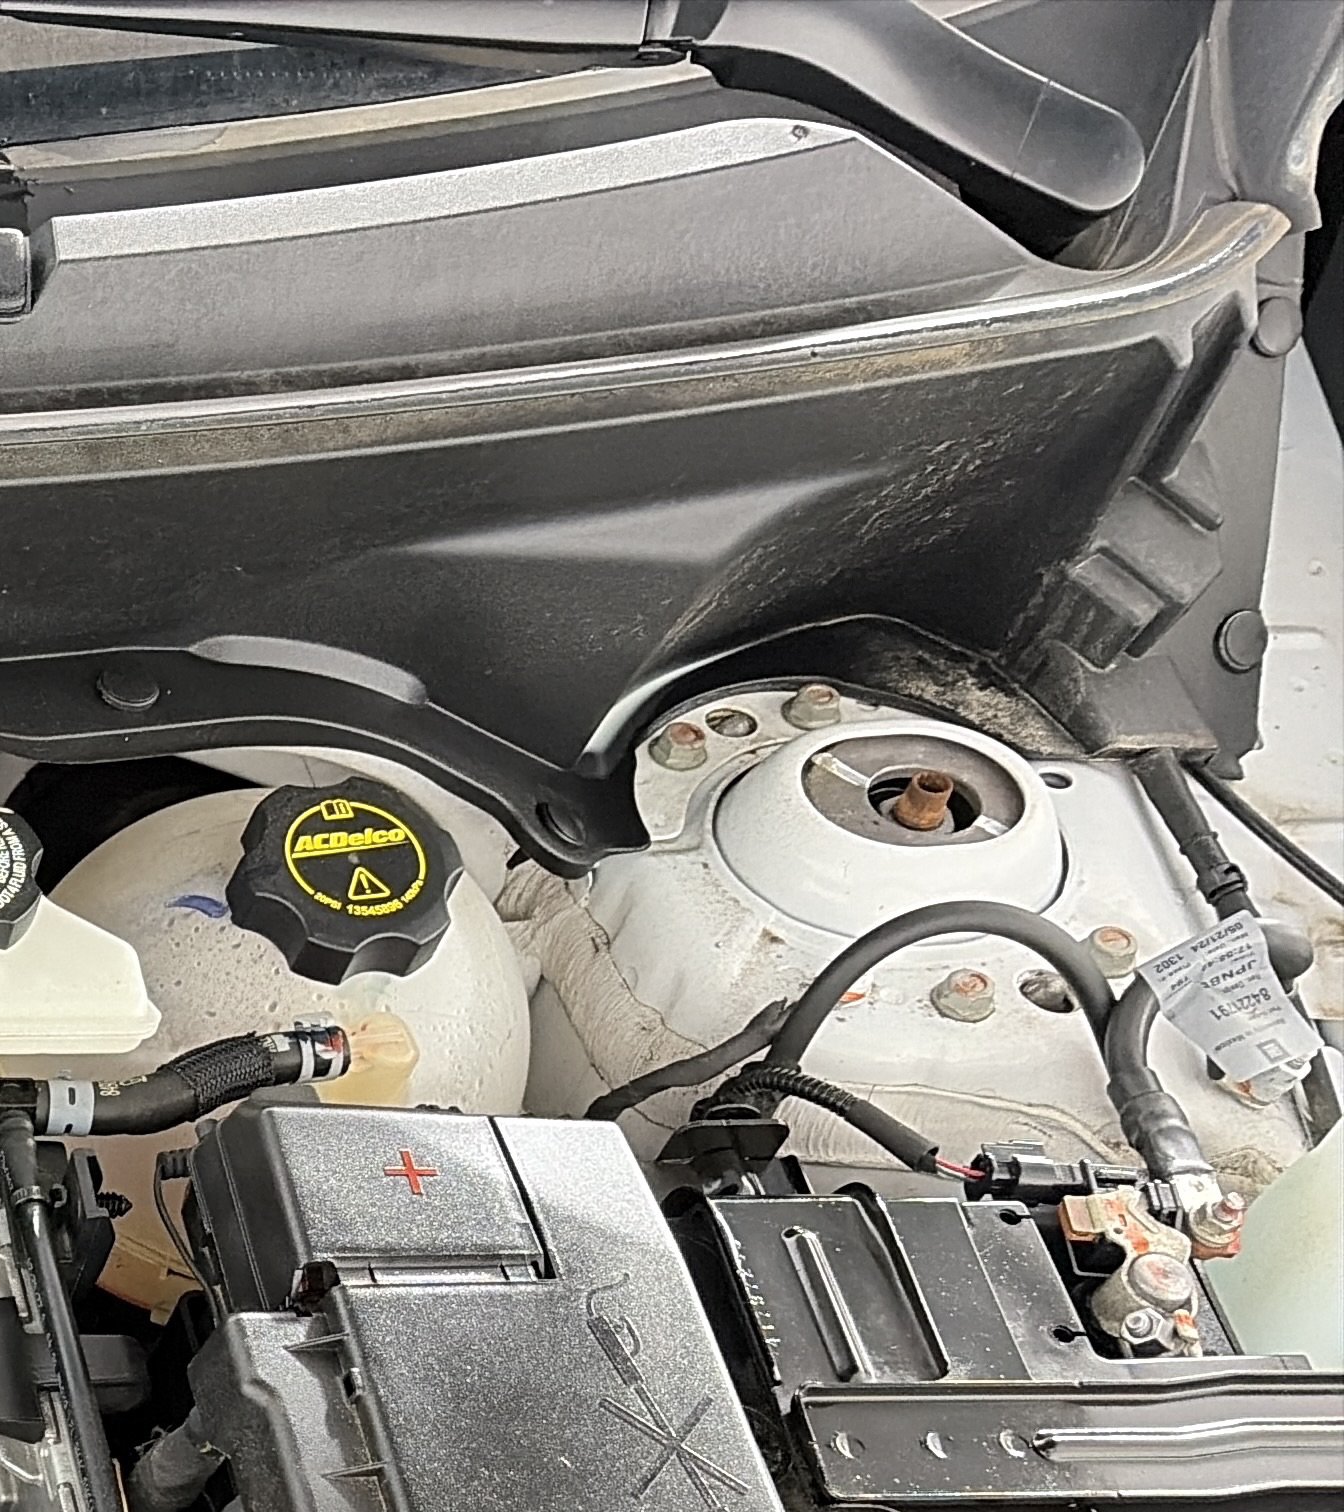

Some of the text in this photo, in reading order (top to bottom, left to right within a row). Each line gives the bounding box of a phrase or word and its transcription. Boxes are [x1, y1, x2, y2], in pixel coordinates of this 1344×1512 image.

[6, 835, 26, 861] FROM
[294, 827, 406, 852] ACDelco
[9, 862, 26, 888] FLUID
[1153, 953, 1185, 974] 1302
